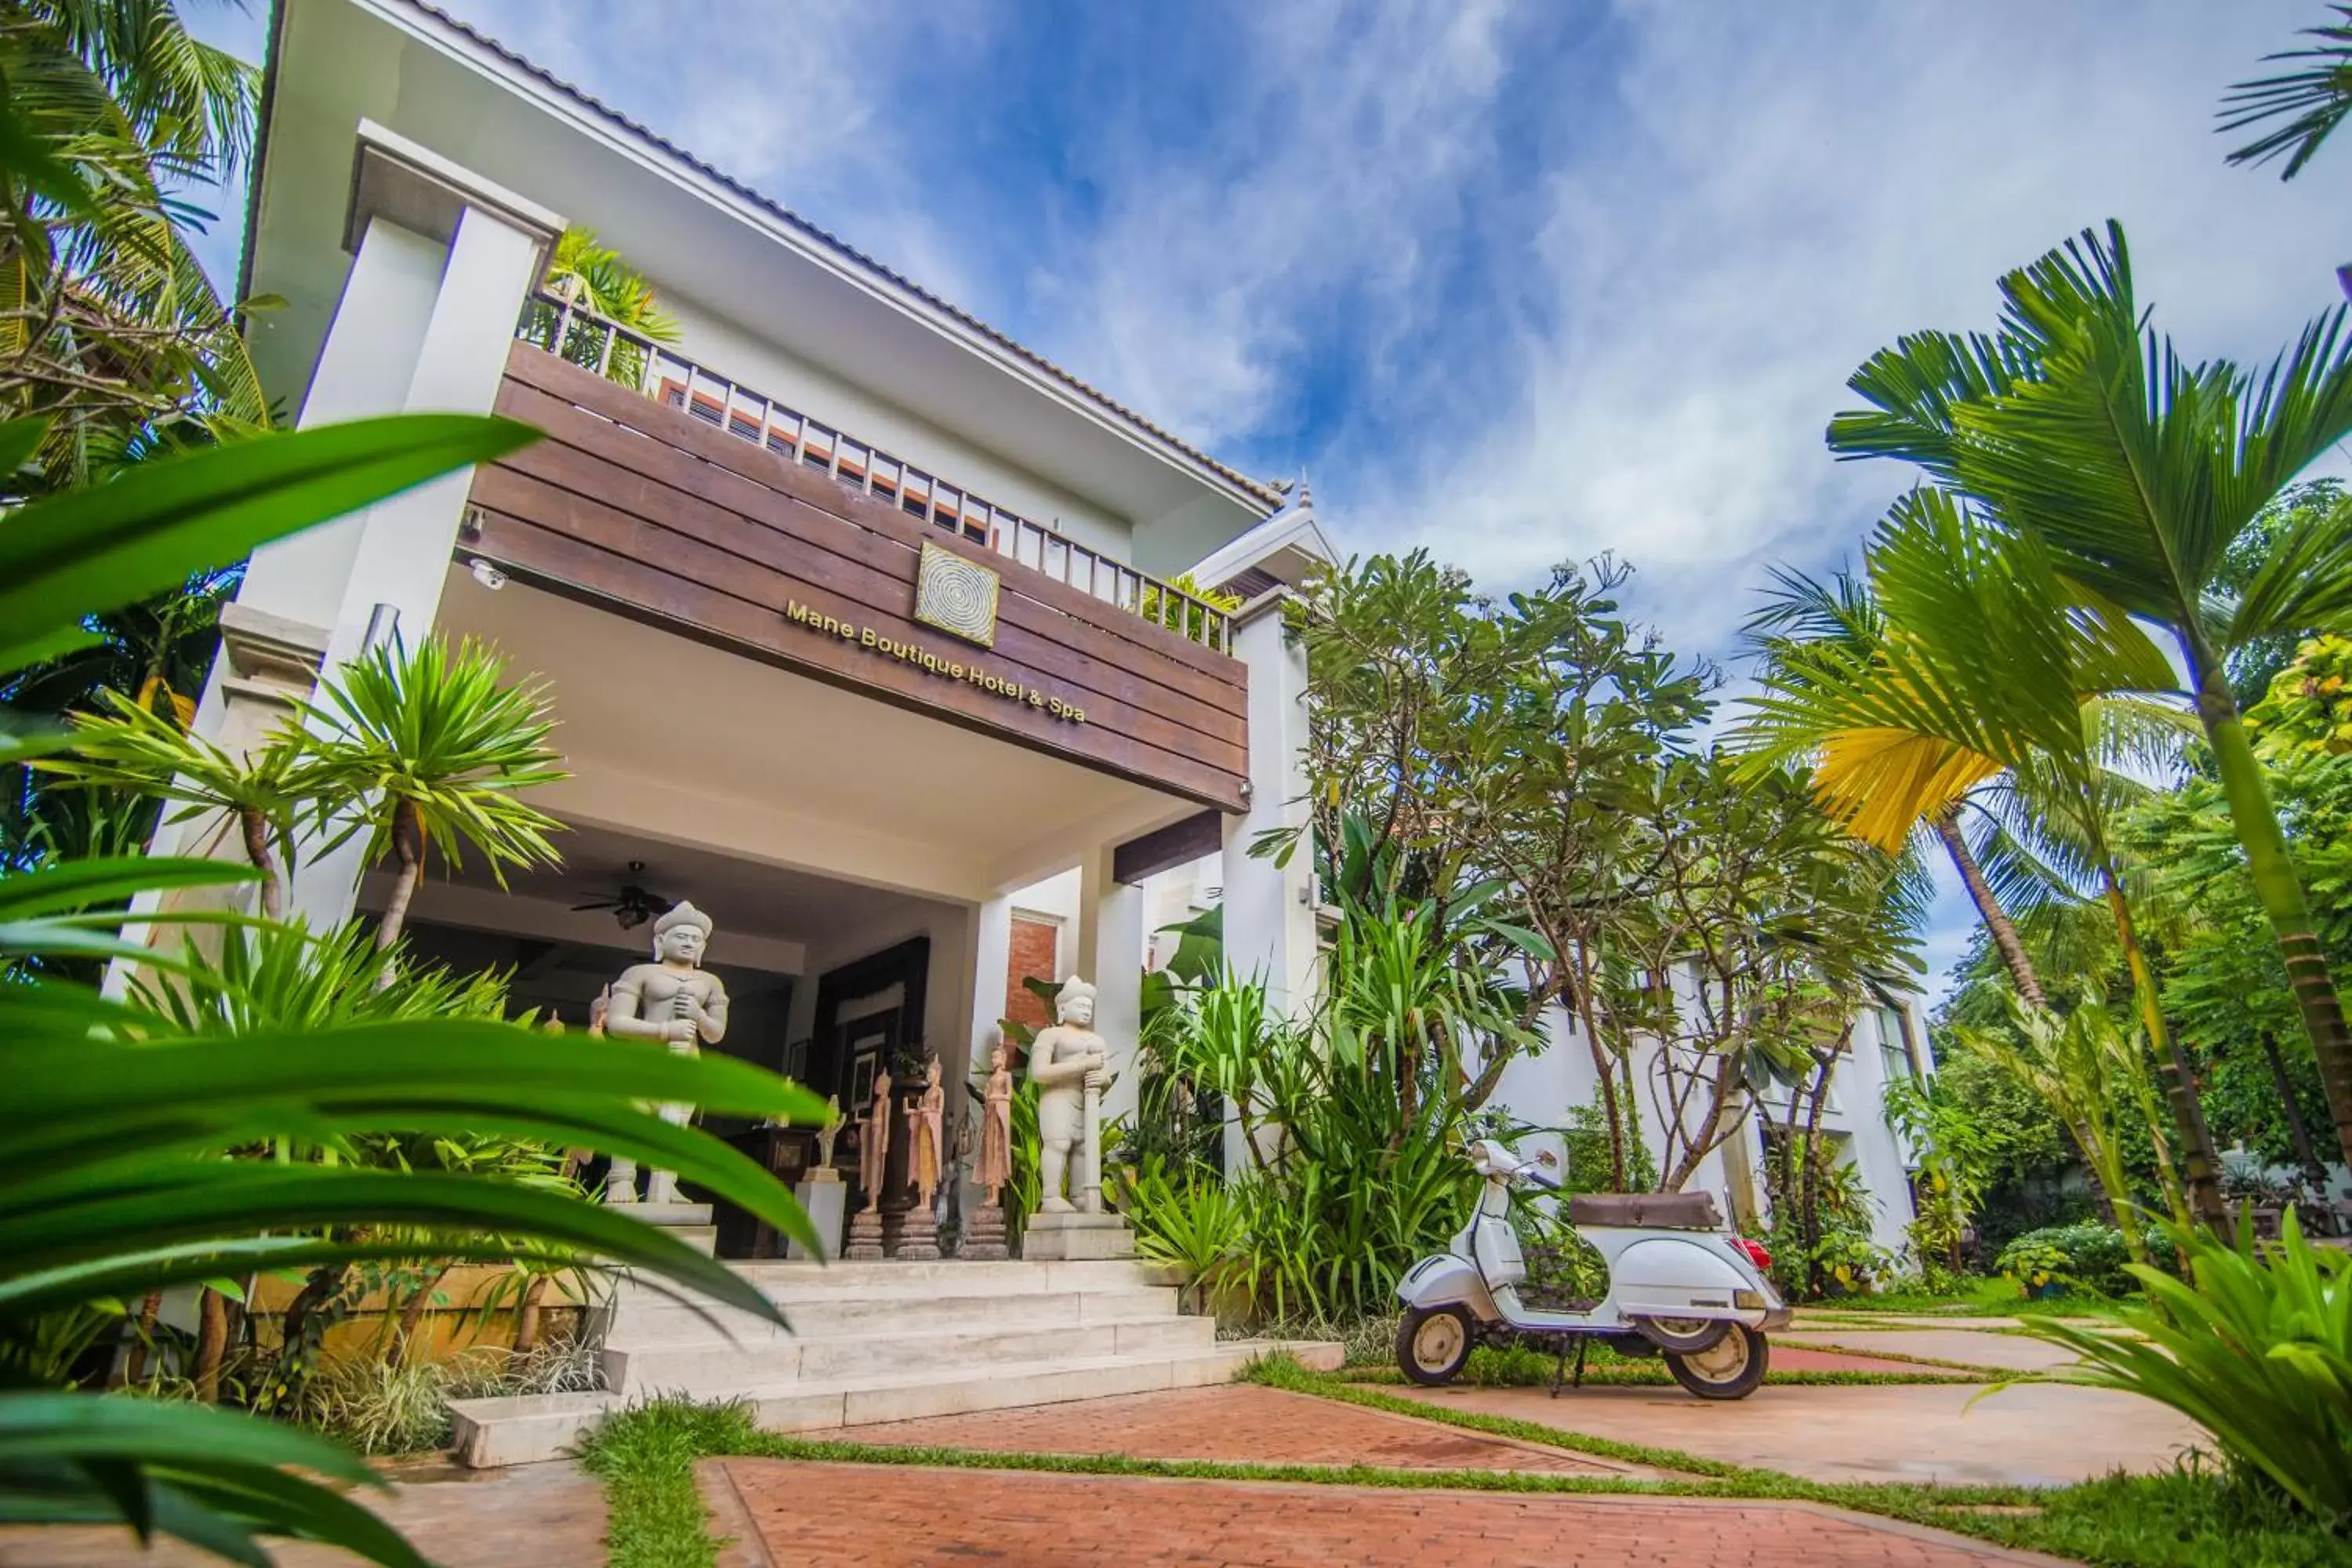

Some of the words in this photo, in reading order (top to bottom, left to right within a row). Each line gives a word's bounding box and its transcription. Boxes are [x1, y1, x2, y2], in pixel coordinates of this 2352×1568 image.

[786, 599, 854, 638] Mane
[861, 626, 964, 678] Boutique
[969, 666, 1023, 700] Hotel
[1029, 689, 1043, 706] &
[1049, 696, 1085, 723] Spa
